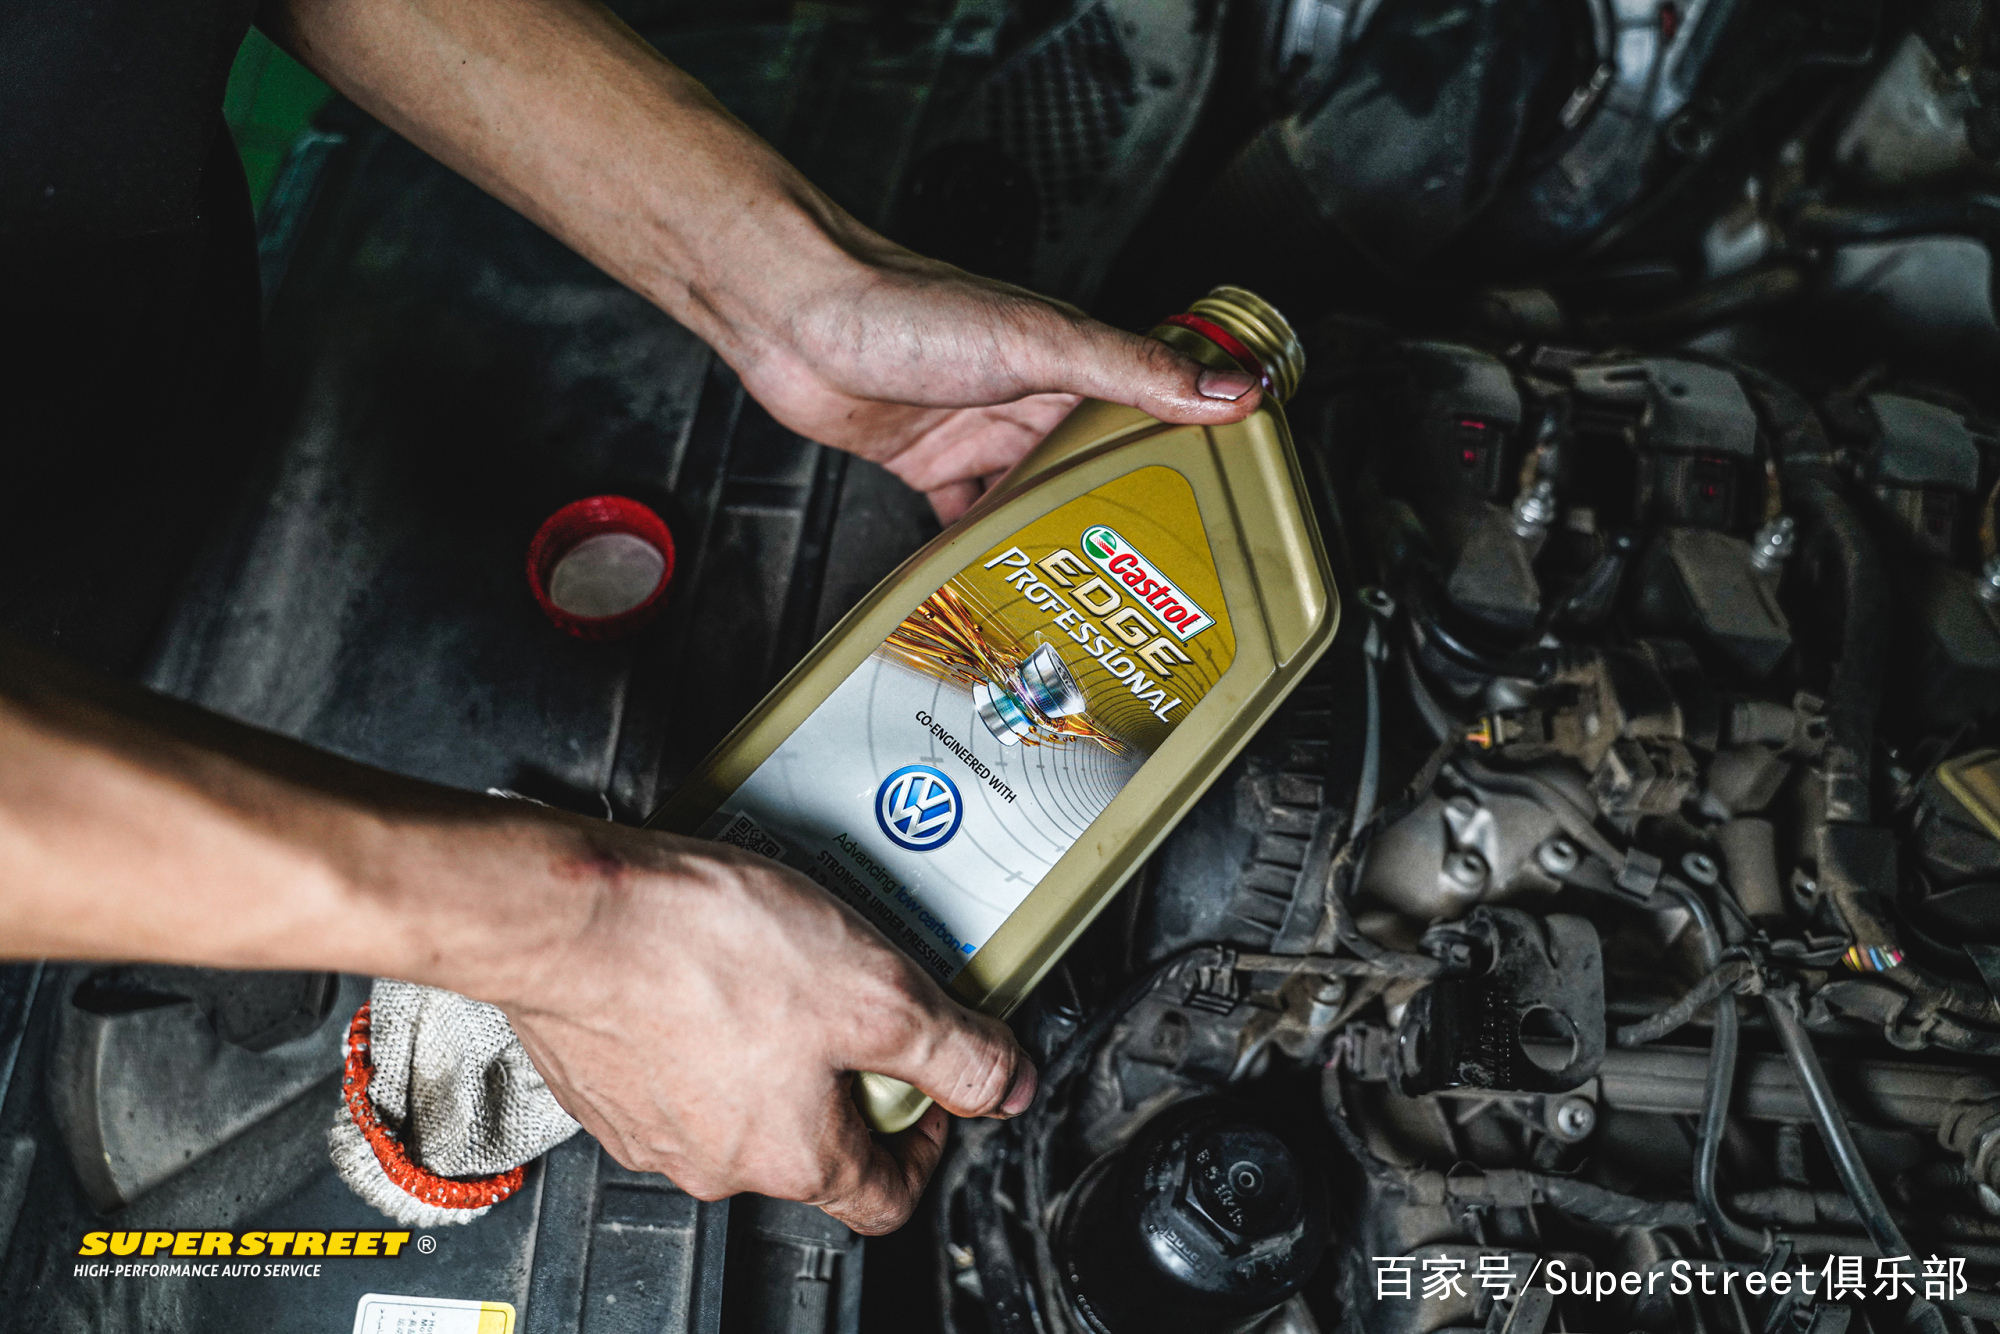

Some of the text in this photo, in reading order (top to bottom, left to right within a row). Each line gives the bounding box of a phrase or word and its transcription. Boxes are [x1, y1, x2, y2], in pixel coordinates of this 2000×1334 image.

[984, 546, 1183, 724] PROFESSIONAL
[1035, 548, 1194, 677] EDGE
[1109, 553, 1202, 635] Castrol
[914, 709, 1018, 805] CO-ENGINEERED WITH
[816, 850, 871, 900] STRONGER
[868, 895, 909, 934] UNDER
[901, 924, 955, 979] PRESSURE
[832, 831, 898, 894] Advancing
[893, 885, 922, 914] low
[918, 909, 962, 954] carbon
